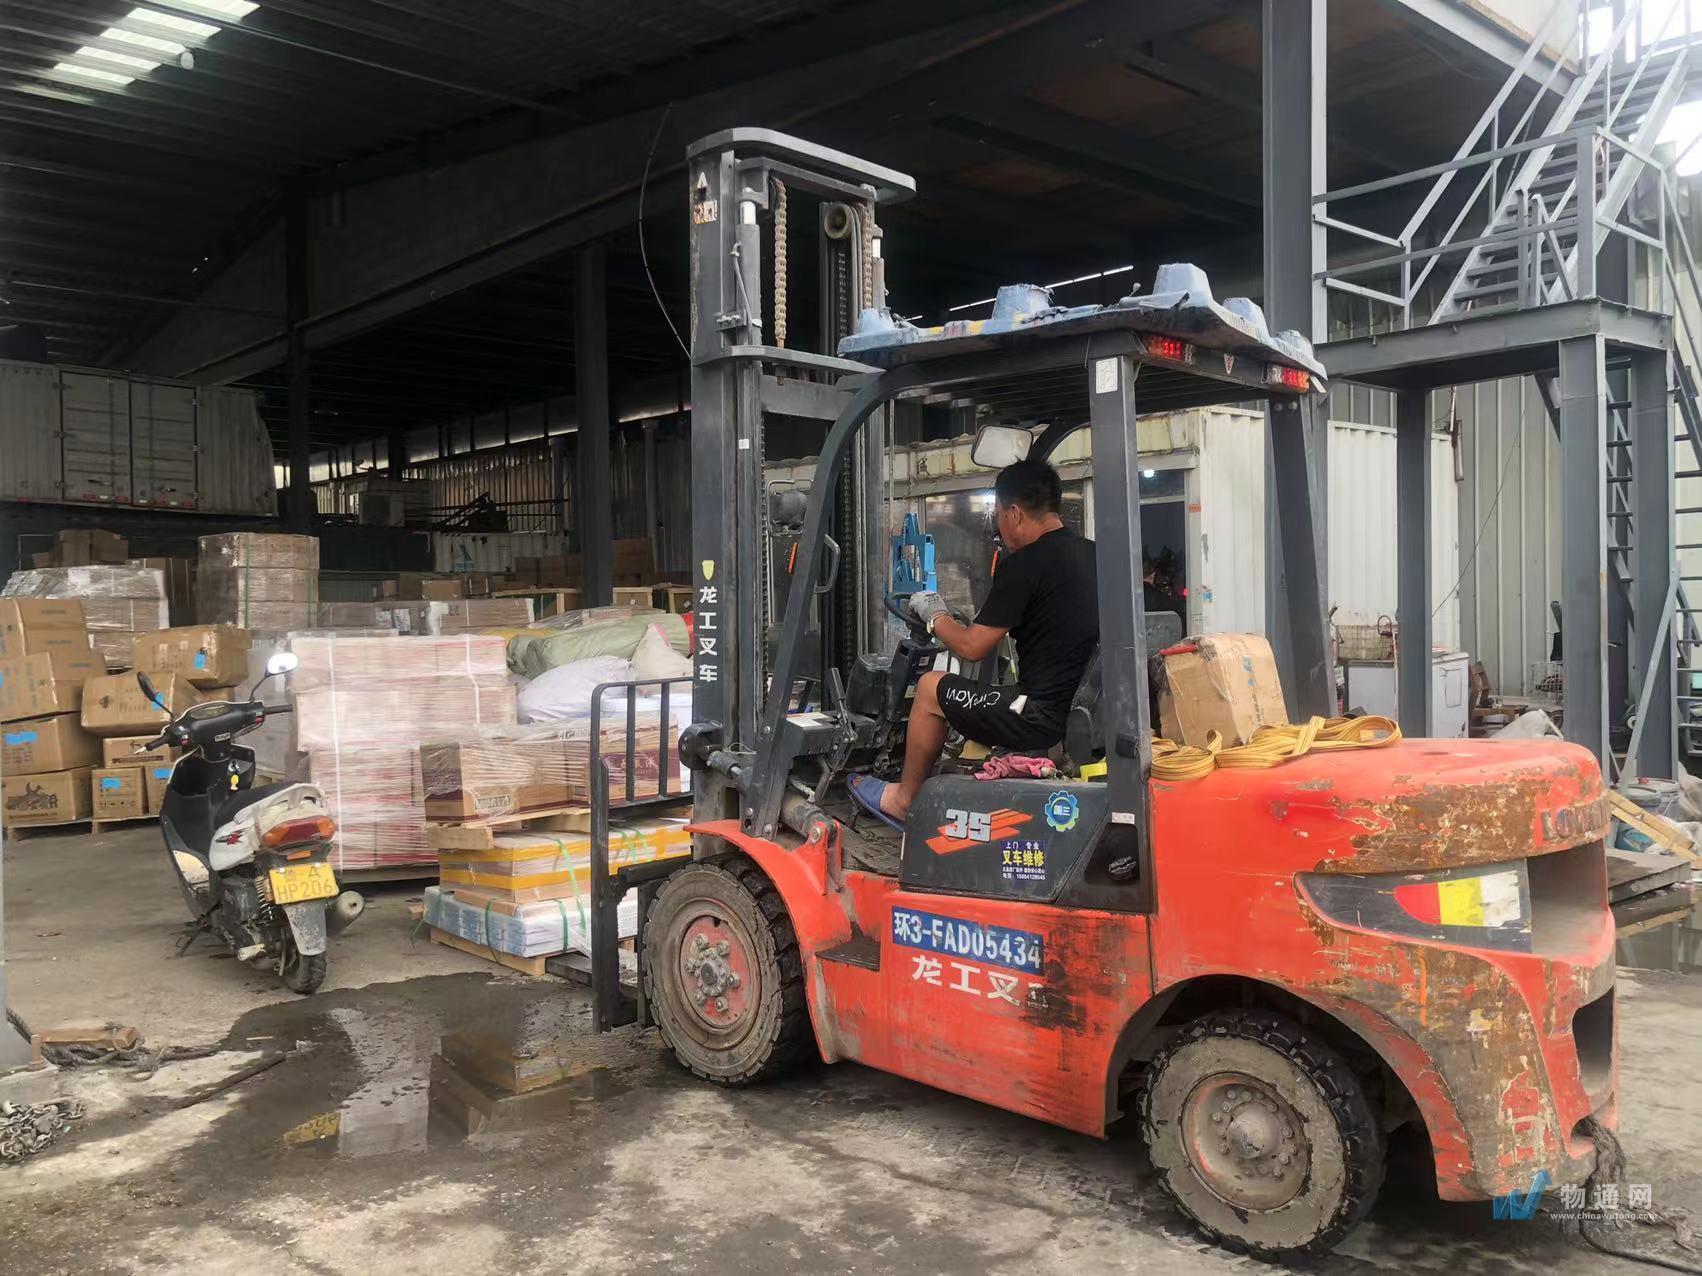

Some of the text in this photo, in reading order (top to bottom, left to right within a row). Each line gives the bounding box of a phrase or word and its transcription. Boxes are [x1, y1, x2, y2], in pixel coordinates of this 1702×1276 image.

[699, 586, 718, 682] 龙工叉车
[1002, 849, 1045, 867] 叉车维修
[277, 879, 333, 900] HP206
[894, 911, 1042, 970] 环3-FAD05434
[911, 954, 1049, 1008] 龙工叉
